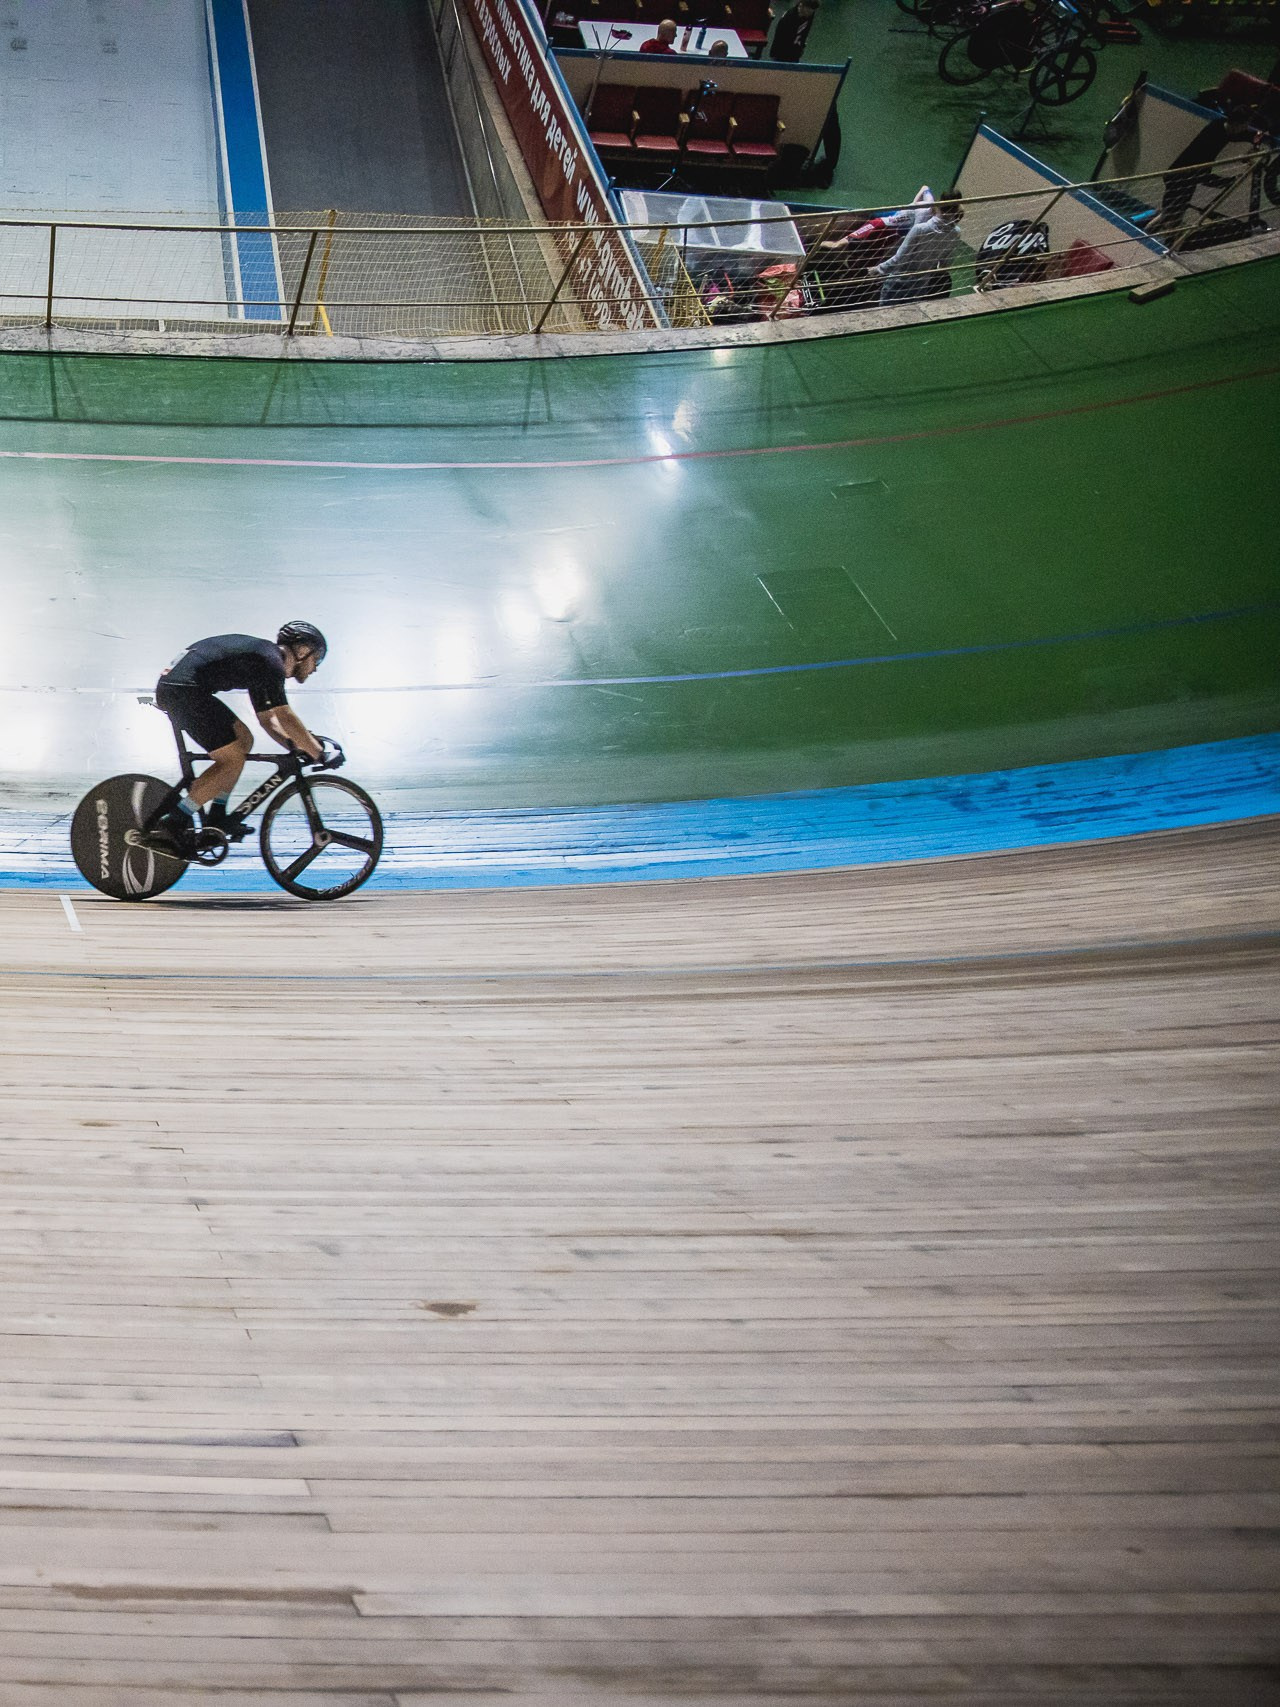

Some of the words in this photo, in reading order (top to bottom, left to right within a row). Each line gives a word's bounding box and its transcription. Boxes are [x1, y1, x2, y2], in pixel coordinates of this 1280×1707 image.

[479, 0, 512, 85] взрослых
[496, 0, 535, 90] имнастика
[530, 78, 551, 126] для
[545, 119, 578, 185] детей
[235, 774, 283, 815] DOLAN
